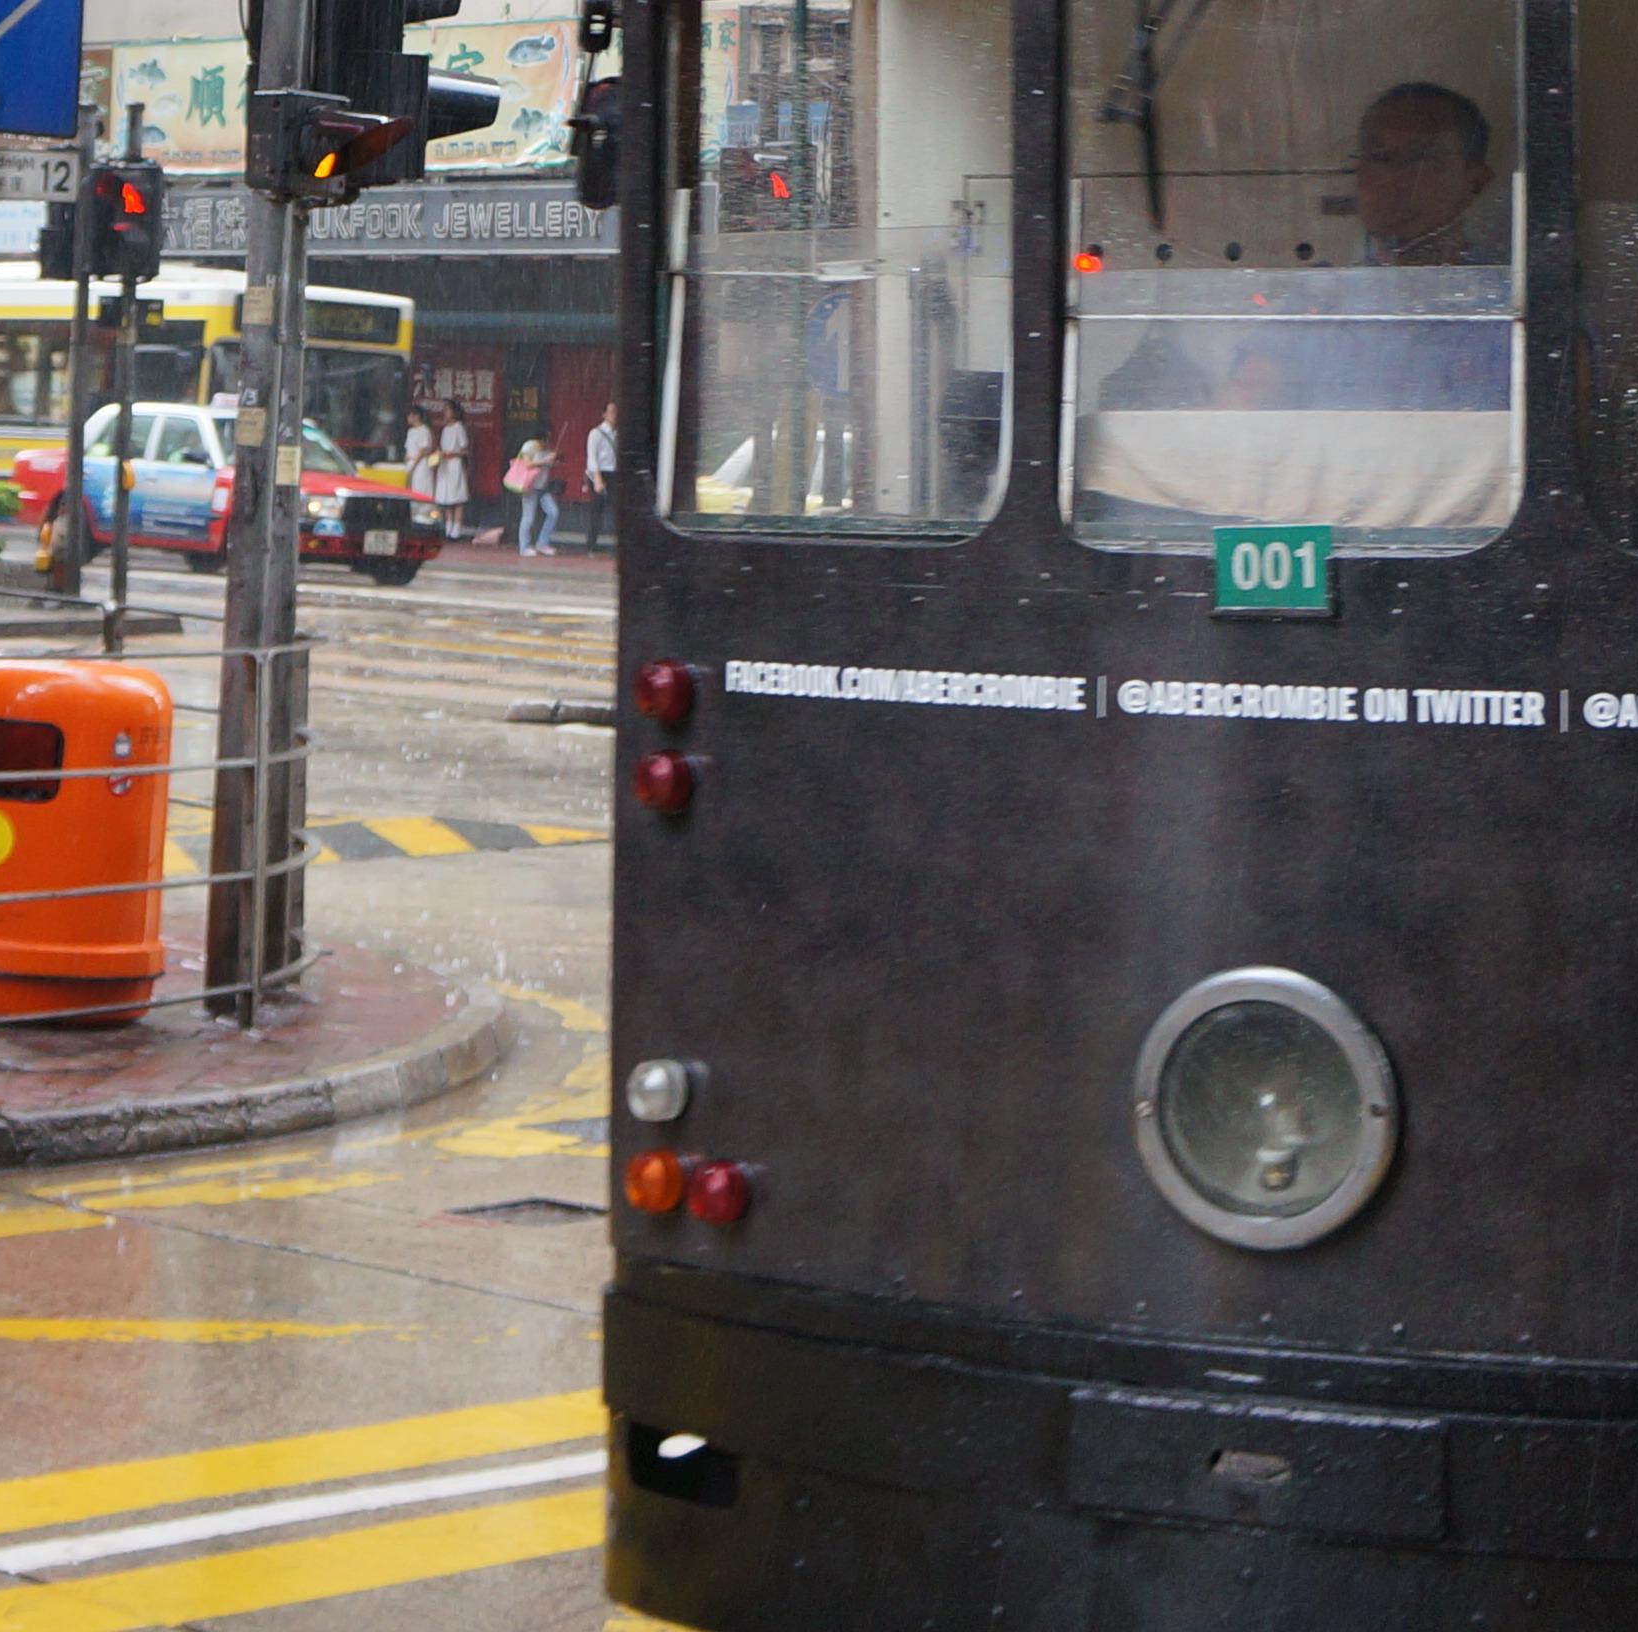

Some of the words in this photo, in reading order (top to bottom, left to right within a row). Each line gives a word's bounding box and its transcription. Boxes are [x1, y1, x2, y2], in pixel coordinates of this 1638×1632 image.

[41, 160, 70, 193] 12
[432, 201, 603, 241] JEWELLERY
[1231, 541, 1318, 591] 001
[1117, 678, 1358, 723] @ABERCROMBIE
[1363, 687, 1408, 724] ON
[1413, 688, 1545, 727] TWITTER
